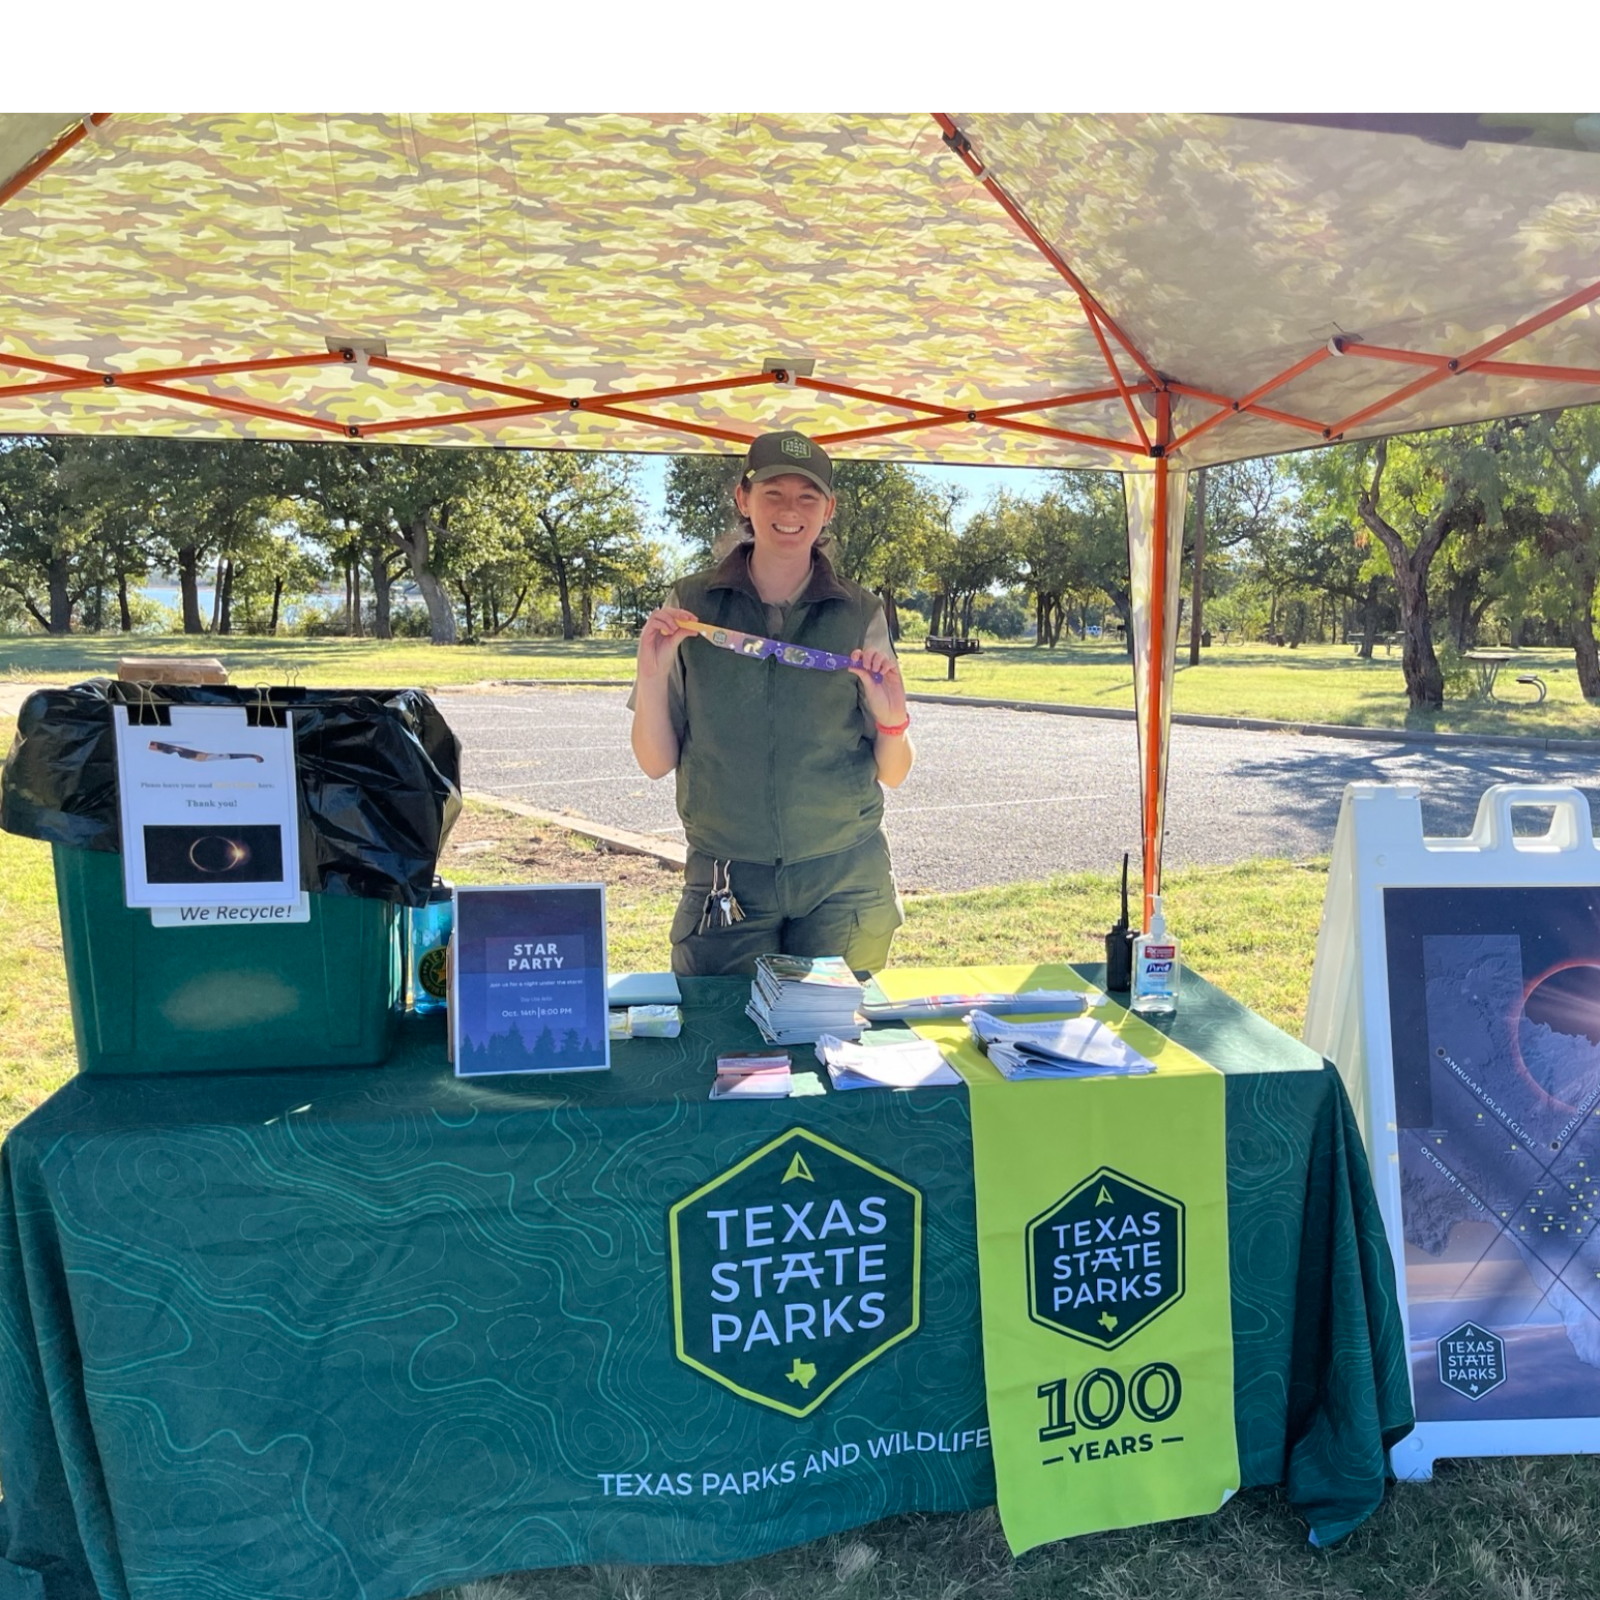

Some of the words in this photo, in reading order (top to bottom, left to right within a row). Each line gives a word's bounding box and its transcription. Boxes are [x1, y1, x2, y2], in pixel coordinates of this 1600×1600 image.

[186, 799, 216, 808] Thank
[217, 799, 238, 810] you!
[180, 906, 210, 921] We
[216, 904, 292, 922] Recycle!
[507, 956, 564, 971] PARTY
[512, 942, 558, 957] STAR
[502, 1010, 519, 1018] Oct.
[560, 1007, 572, 1015] PM
[1444, 1056, 1482, 1095] ANNULAR
[1482, 1093, 1507, 1119] SOLAR
[1506, 1118, 1537, 1149] ECLIPSE
[1557, 1116, 1579, 1141] TOTAL
[1577, 1090, 1599, 1116] SOLAR
[1420, 1146, 1456, 1183] OCTOBER
[1466, 1193, 1486, 1212] 2023
[706, 1196, 887, 1251] TEXAS
[1052, 1211, 1161, 1249] TEXAS
[710, 1243, 887, 1303] STATE
[1052, 1241, 1162, 1280] STATE
[1053, 1272, 1162, 1312] PARKS
[710, 1292, 886, 1353] PARKS
[1447, 1340, 1495, 1353] TEXAS
[1448, 1354, 1496, 1367] STATE
[1448, 1367, 1497, 1381] PARKS
[1037, 1361, 1182, 1443] 100
[597, 1472, 693, 1497] TEXAS
[701, 1460, 796, 1496] PARKS
[803, 1442, 860, 1478] AND
[867, 1426, 990, 1459] WILDLIFE
[1068, 1433, 1154, 1463] YEARS
